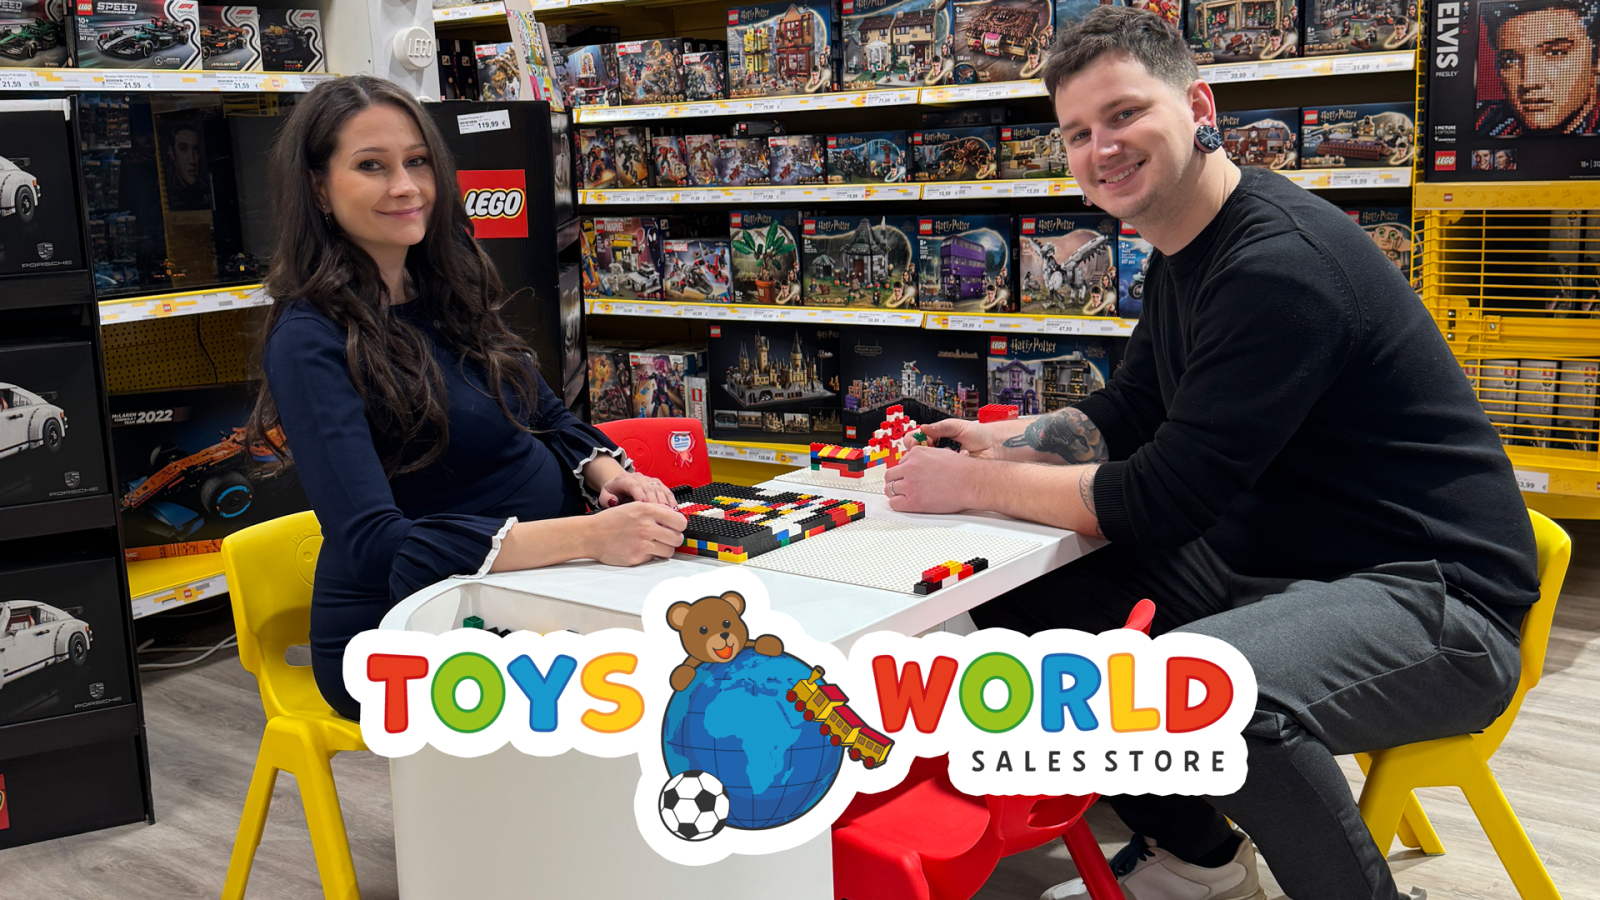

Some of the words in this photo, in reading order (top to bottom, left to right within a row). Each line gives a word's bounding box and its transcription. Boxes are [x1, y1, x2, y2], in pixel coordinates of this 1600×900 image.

[97, 2, 138, 12] SPEED
[1436, 3, 1460, 69] ELVIS
[408, 38, 432, 57] LEGO
[1320, 110, 1338, 122] Harry
[1338, 108, 1358, 120] Potter
[478, 121, 499, 129] 119,99
[924, 134, 937, 142] Harry
[1014, 128, 1026, 138] Harry
[1436, 156, 1454, 165] LEGO
[464, 190, 522, 218] LEGO
[743, 214, 757, 225] Harry
[757, 213, 772, 224] Potter
[1362, 211, 1380, 223] Harry
[1380, 210, 1398, 221] Potter
[606, 222, 624, 232] MARVEL
[818, 220, 833, 232] Harry
[833, 219, 850, 231] Potter
[934, 221, 952, 234] Harry
[952, 219, 970, 231] Potter
[1022, 222, 1034, 230] LEGO
[1038, 220, 1056, 233] Harry
[1056, 218, 1075, 230] Potter
[21, 259, 72, 268] PORSCHE
[992, 341, 1006, 349] LEGO
[1010, 338, 1033, 354] Harry
[1033, 337, 1056, 353] Potter
[136, 409, 173, 424] 2022
[48, 486, 99, 497] PORSCHE
[74, 696, 123, 709] PORSCHE
